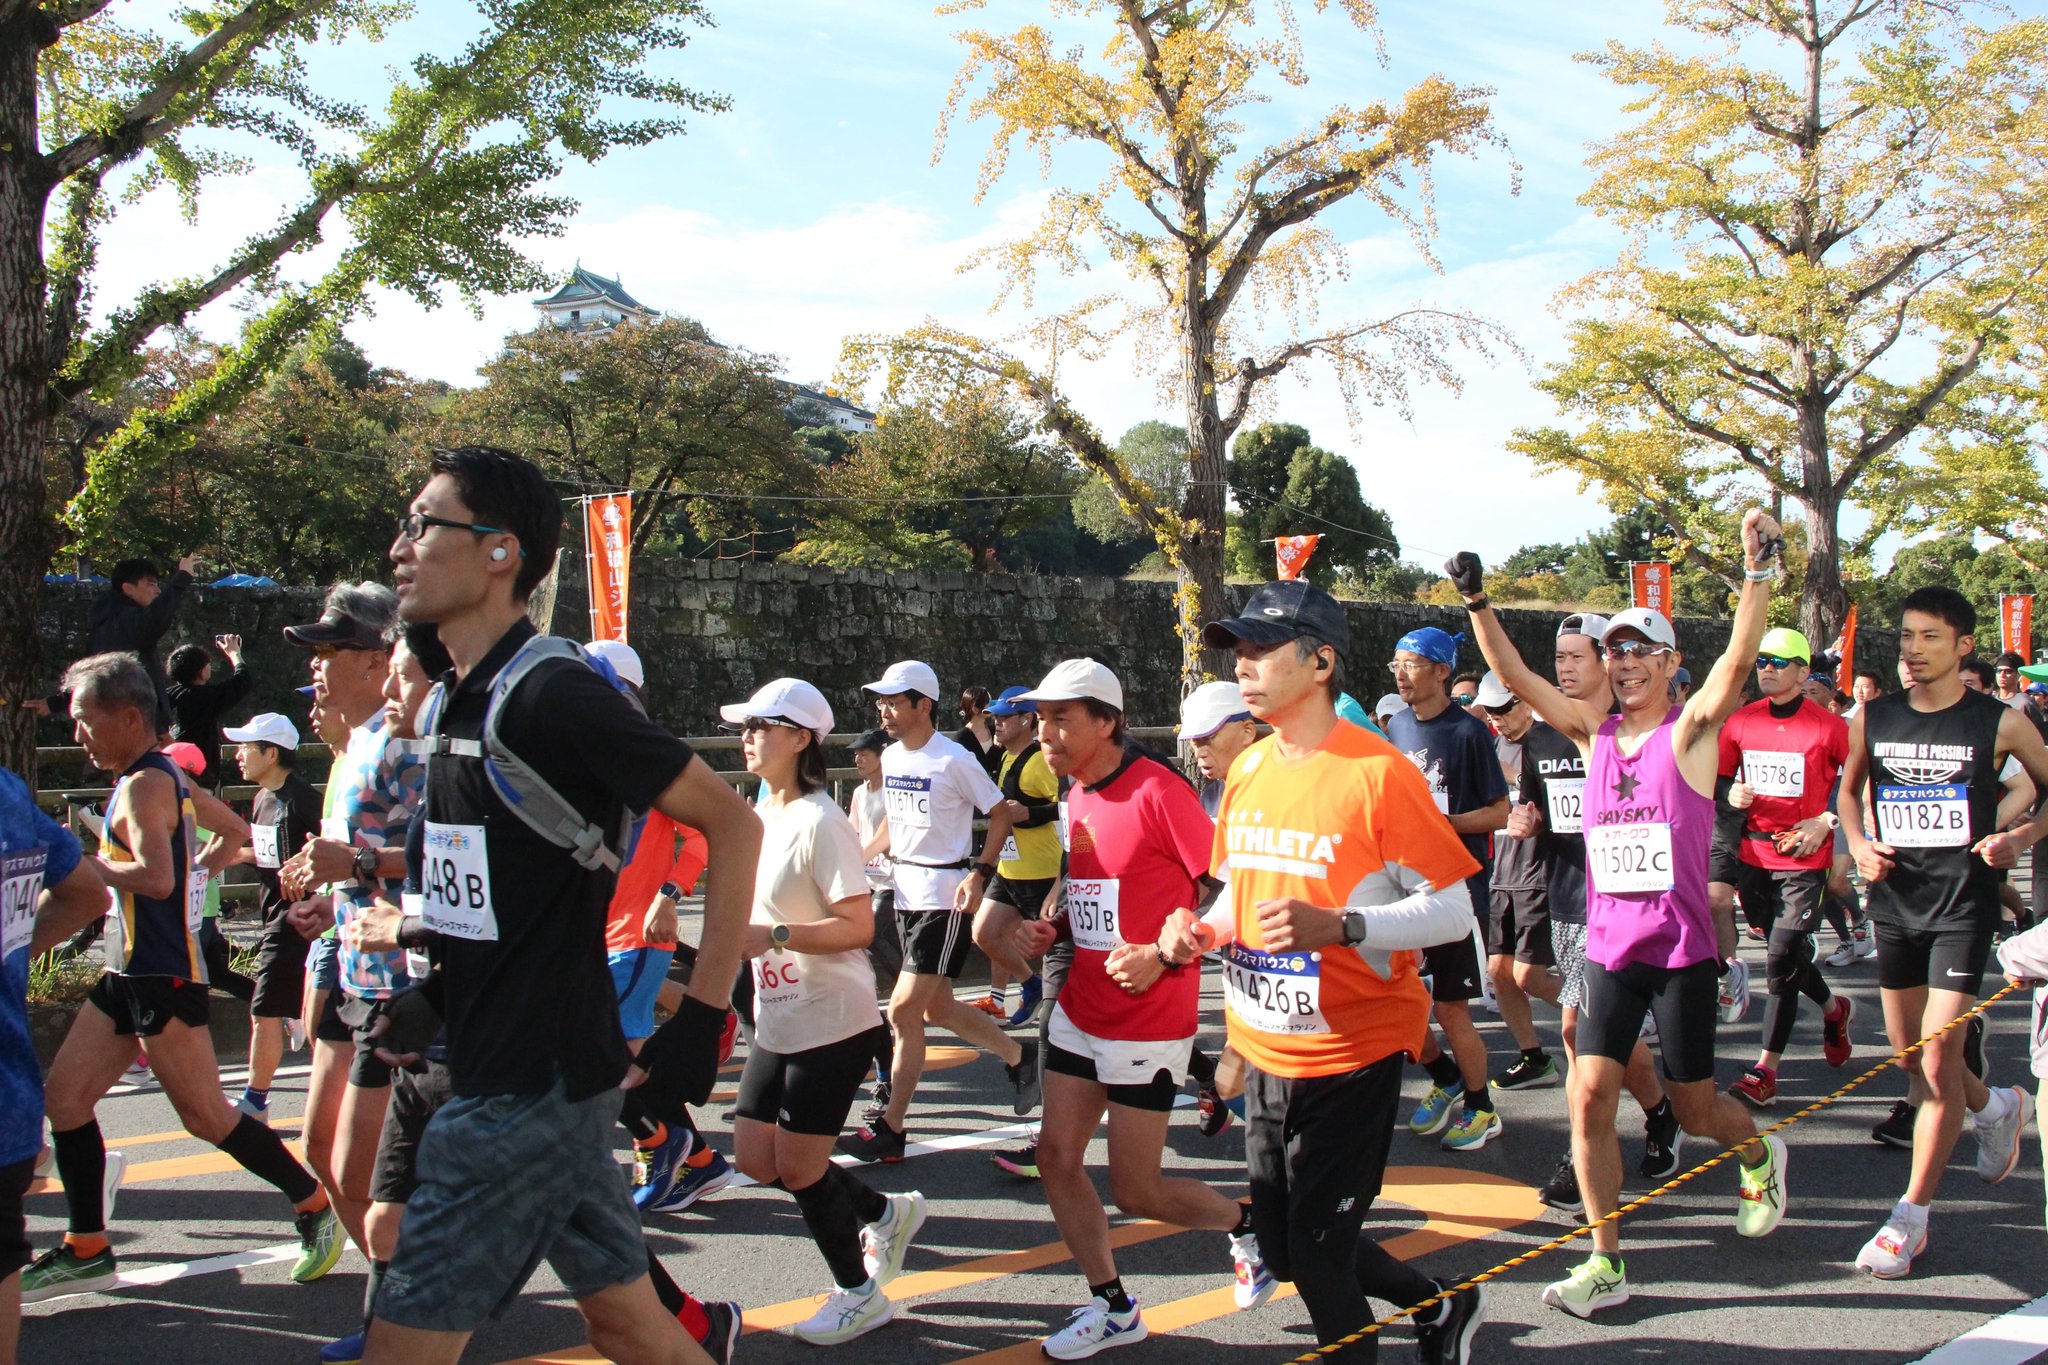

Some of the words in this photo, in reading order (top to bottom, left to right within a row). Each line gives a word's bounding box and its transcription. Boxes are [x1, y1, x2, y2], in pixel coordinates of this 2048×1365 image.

[1874, 742, 1917, 759] ANYTHING
[1918, 744, 1929, 759] IS
[1929, 744, 1974, 761] POSSIBLE
[1746, 763, 1787, 785] 11578
[1790, 771, 1801, 786] C
[887, 790, 914, 812] 11671
[918, 798, 928, 814] C
[1891, 789, 1945, 799] アズマハウス
[1597, 806, 1659, 825] SAYSKY
[1881, 803, 1944, 830] 10182
[1949, 810, 1964, 829] B
[1612, 828, 1650, 839] オークワ
[1593, 844, 1648, 874] 11502
[1652, 851, 1668, 872] C
[465, 873, 485, 909] B
[1073, 883, 1102, 896] オークワ
[1103, 910, 1114, 932] B
[1236, 949, 1291, 970] アズマハウス
[780, 962, 800, 985] C
[1226, 964, 1291, 1015] 11426
[1295, 990, 1315, 1016] B
